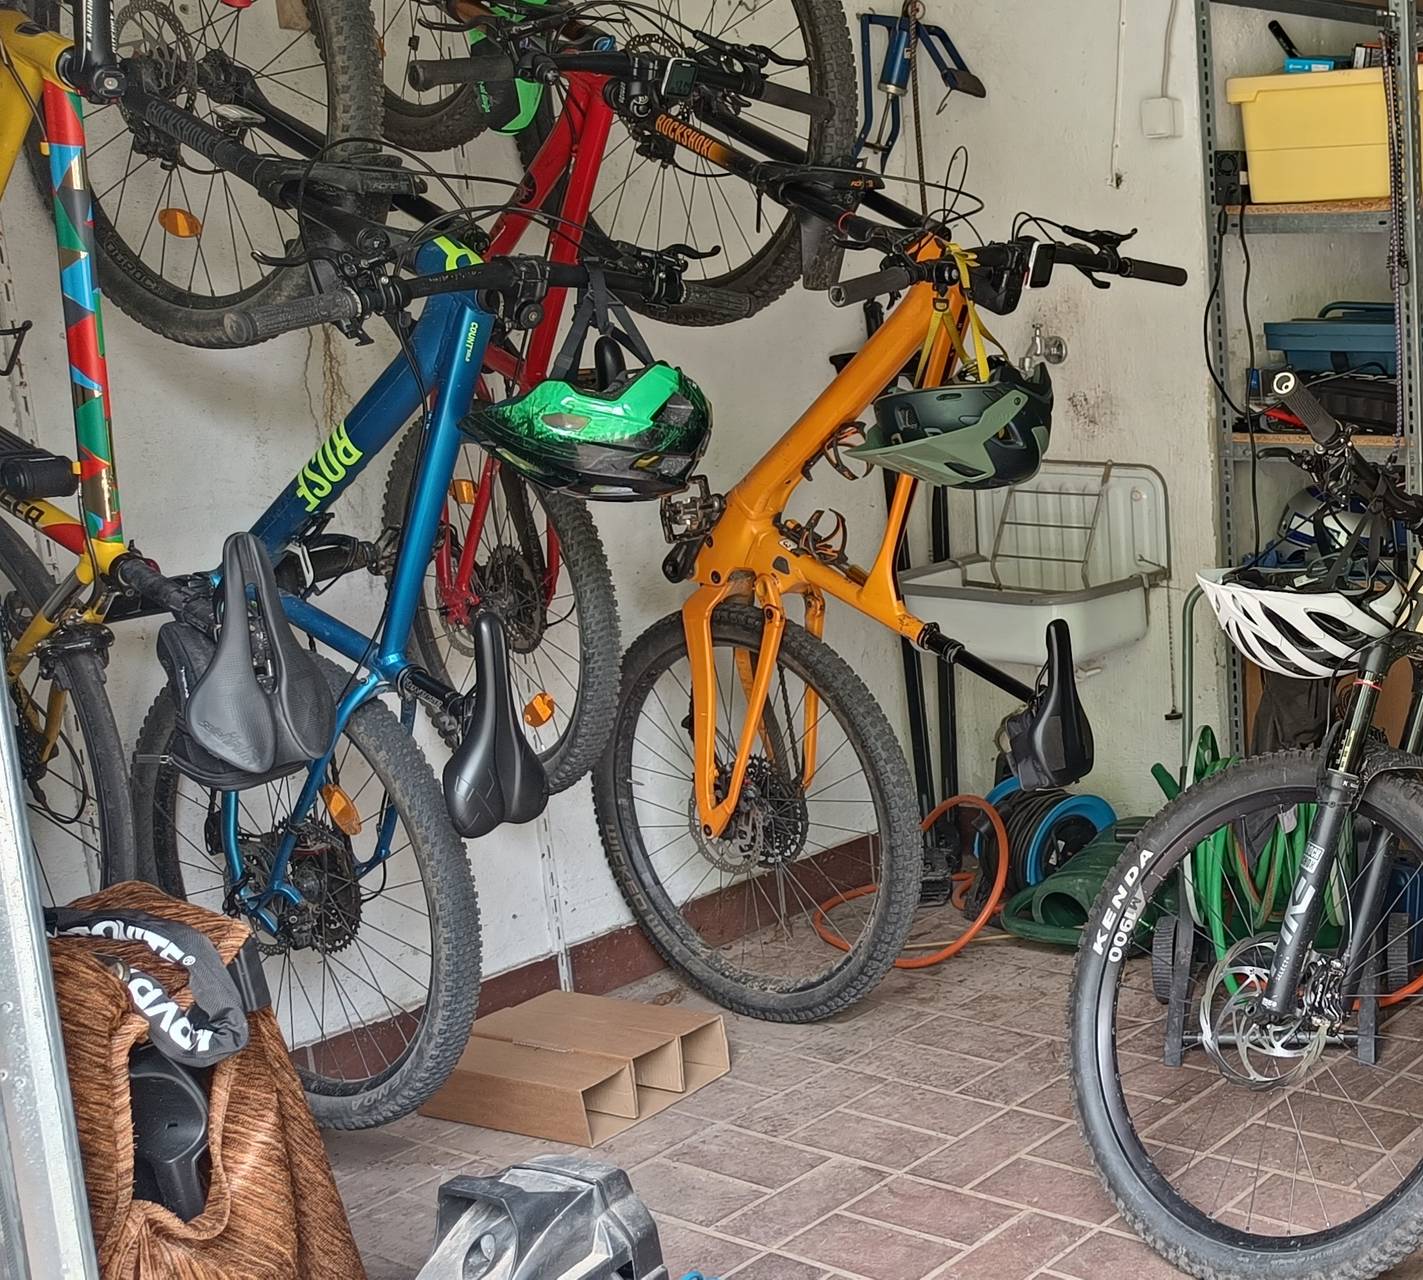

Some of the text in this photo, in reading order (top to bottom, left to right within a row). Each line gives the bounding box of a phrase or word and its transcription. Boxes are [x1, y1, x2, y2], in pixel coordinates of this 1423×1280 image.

[296, 421, 364, 513] ROSE
[1092, 849, 1154, 956] KENDA
[1108, 896, 1142, 963] M1900
